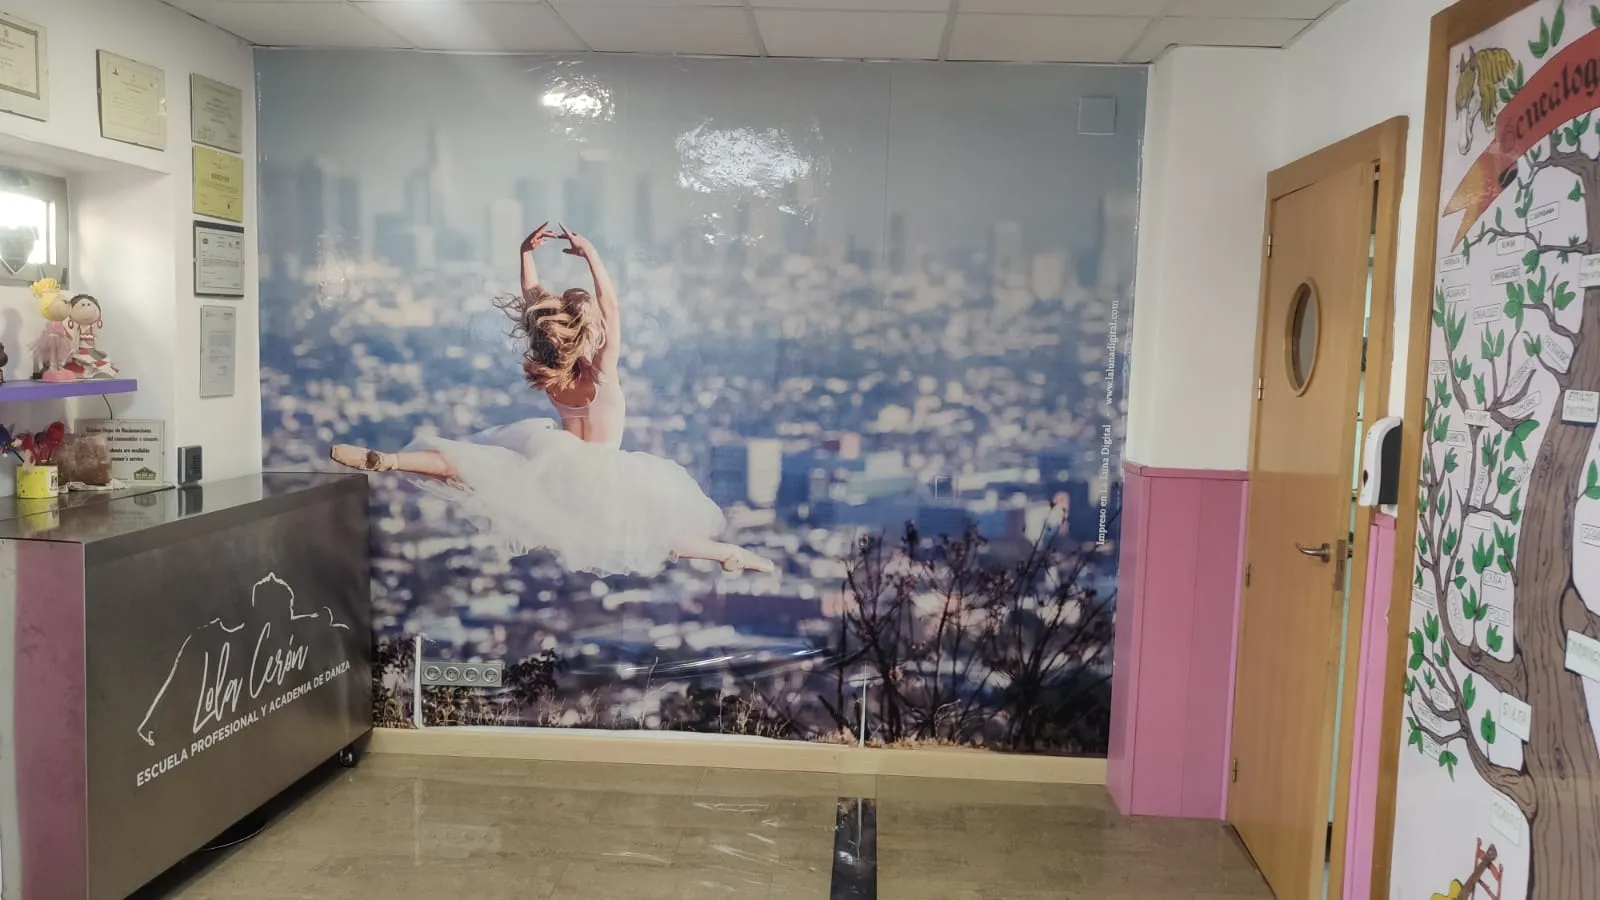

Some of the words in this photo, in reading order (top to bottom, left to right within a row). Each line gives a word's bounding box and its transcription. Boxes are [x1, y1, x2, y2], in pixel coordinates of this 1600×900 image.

[1500, 57, 1600, 154] Genealog
[1104, 299, 1119, 405] www.lalunadigital.com
[1100, 457, 1109, 479] Luna
[1101, 424, 1112, 455] Digital
[1096, 508, 1107, 545] Impreso
[1100, 495, 1107, 507] en
[193, 642, 243, 734] Lola
[249, 622, 309, 699] Cerón
[136, 748, 188, 787] ESCUELA
[191, 708, 259, 757] PROFESIONAL
[260, 703, 267, 717] Y
[268, 680, 313, 713] ACADEMIA
[313, 673, 324, 689] DE
[325, 659, 351, 682] DANZA
